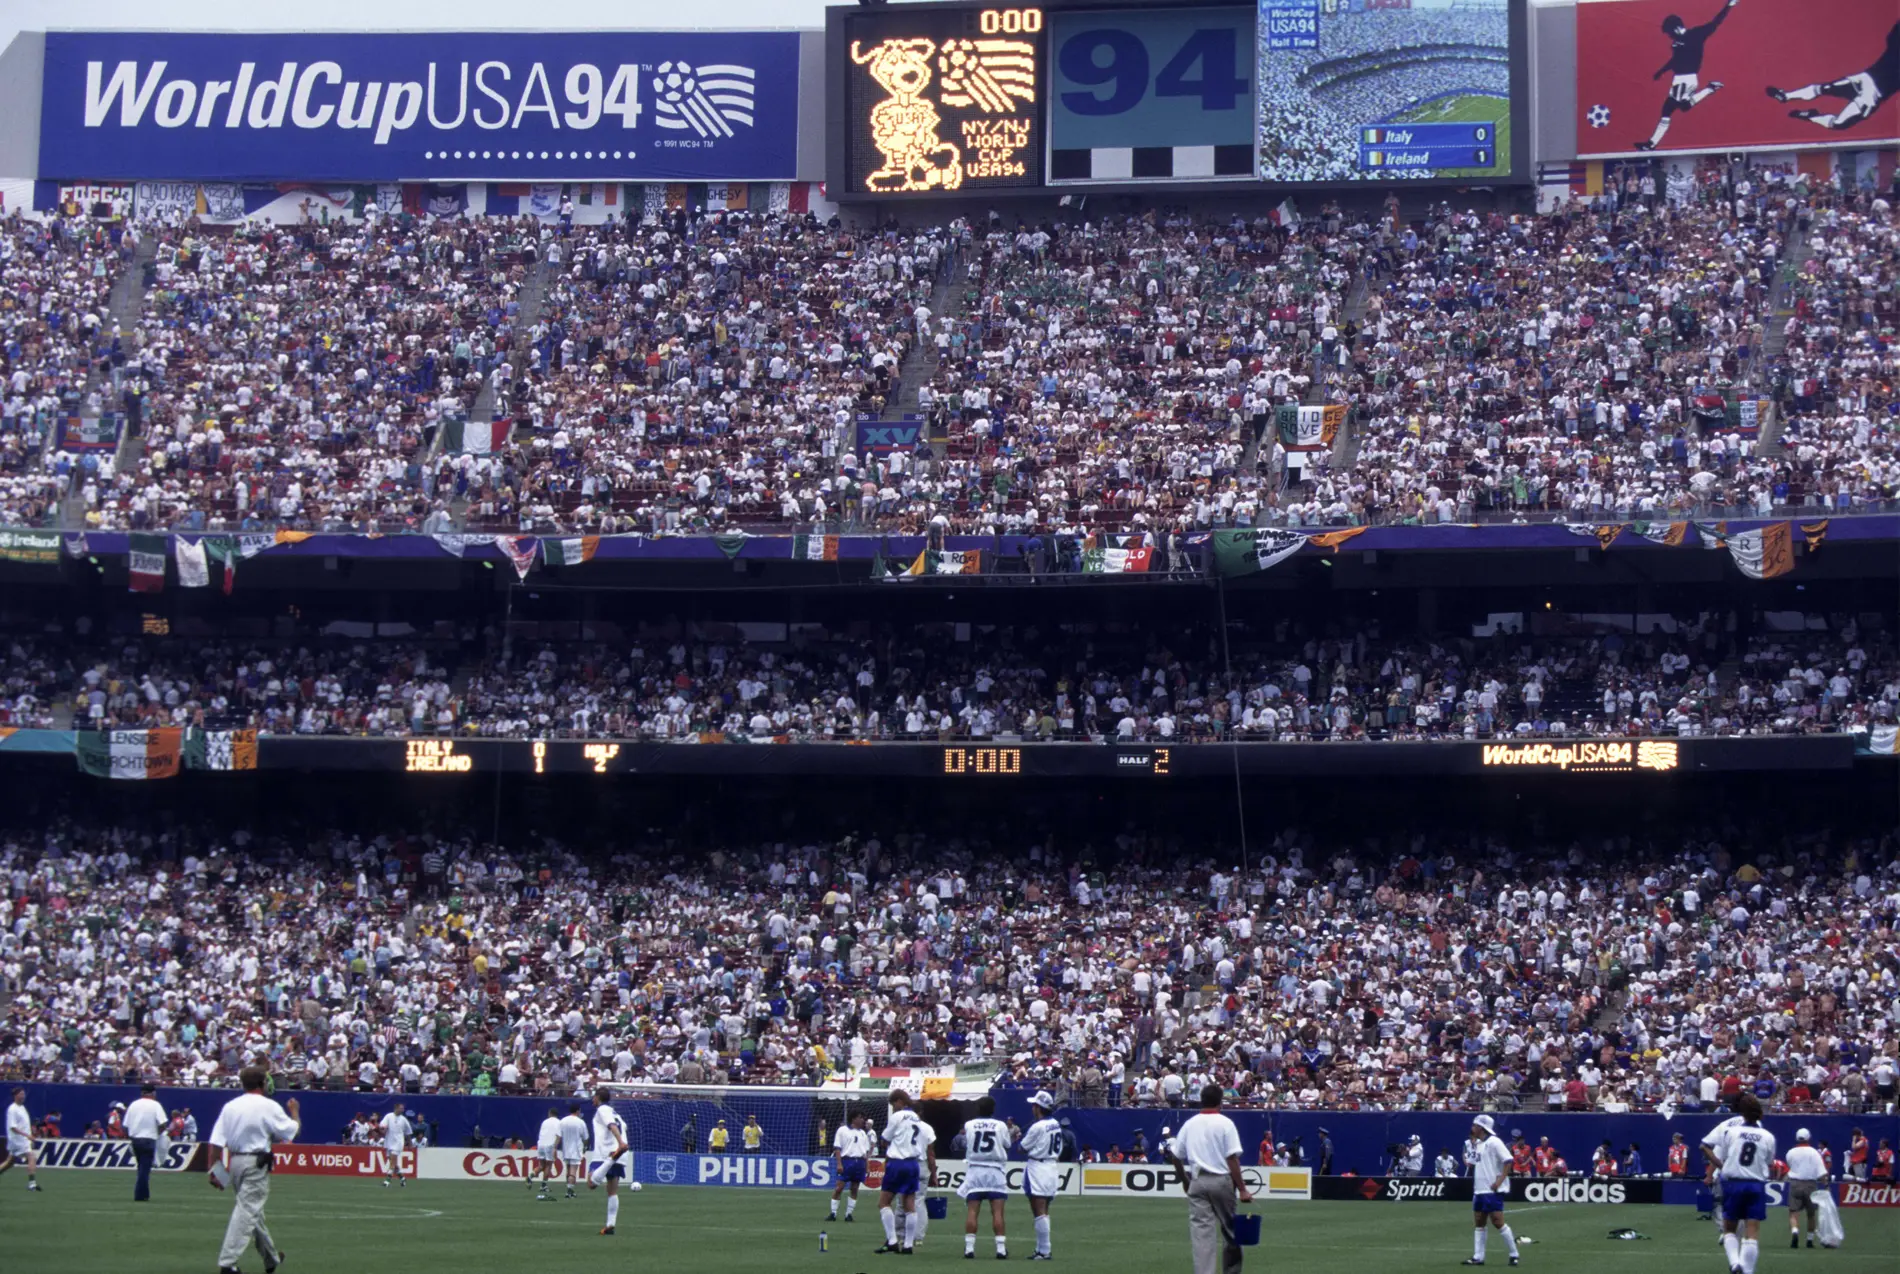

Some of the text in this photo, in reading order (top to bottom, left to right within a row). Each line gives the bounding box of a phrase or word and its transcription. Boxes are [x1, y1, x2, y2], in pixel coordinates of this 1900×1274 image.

[980, 9, 1042, 34] 0:00
[1271, 19, 1316, 33] USA94
[1058, 28, 1249, 116] 94
[961, 119, 1030, 135] NY/NJ
[966, 133, 1028, 148] WORLD
[1385, 128, 1486, 145] Italy 0
[1385, 150, 1486, 165] Ireland 1
[966, 162, 1026, 178] USA94
[1281, 410, 1343, 422] BRIDGE
[863, 427, 917, 444] XV
[1281, 424, 1340, 436] ROVERS
[13, 533, 60, 548] Ireland
[101, 731, 160, 745] GLENSIDE
[406, 740, 453, 755] ITALY
[85, 754, 173, 769] CHURCHTOWN
[406, 755, 472, 771] IRELAND
[535, 757, 544, 773] 1
[594, 757, 606, 772] 2
[945, 749, 1020, 773] 0:00
[1119, 749, 1169, 773] HALF 2
[973, 1122, 998, 1131] CONTE
[911, 1124, 920, 1146] 2
[973, 1130, 996, 1153] 15
[1740, 1132, 1763, 1142] MUSSI
[16, 1140, 192, 1170] NICKS
[273, 1152, 353, 1168] TV & VIDEO
[1739, 1142, 1757, 1167] 8
[699, 1156, 831, 1187] PHILIPS
[1386, 1180, 1445, 1200] Sprint
[1525, 1179, 1626, 1203] adidas
